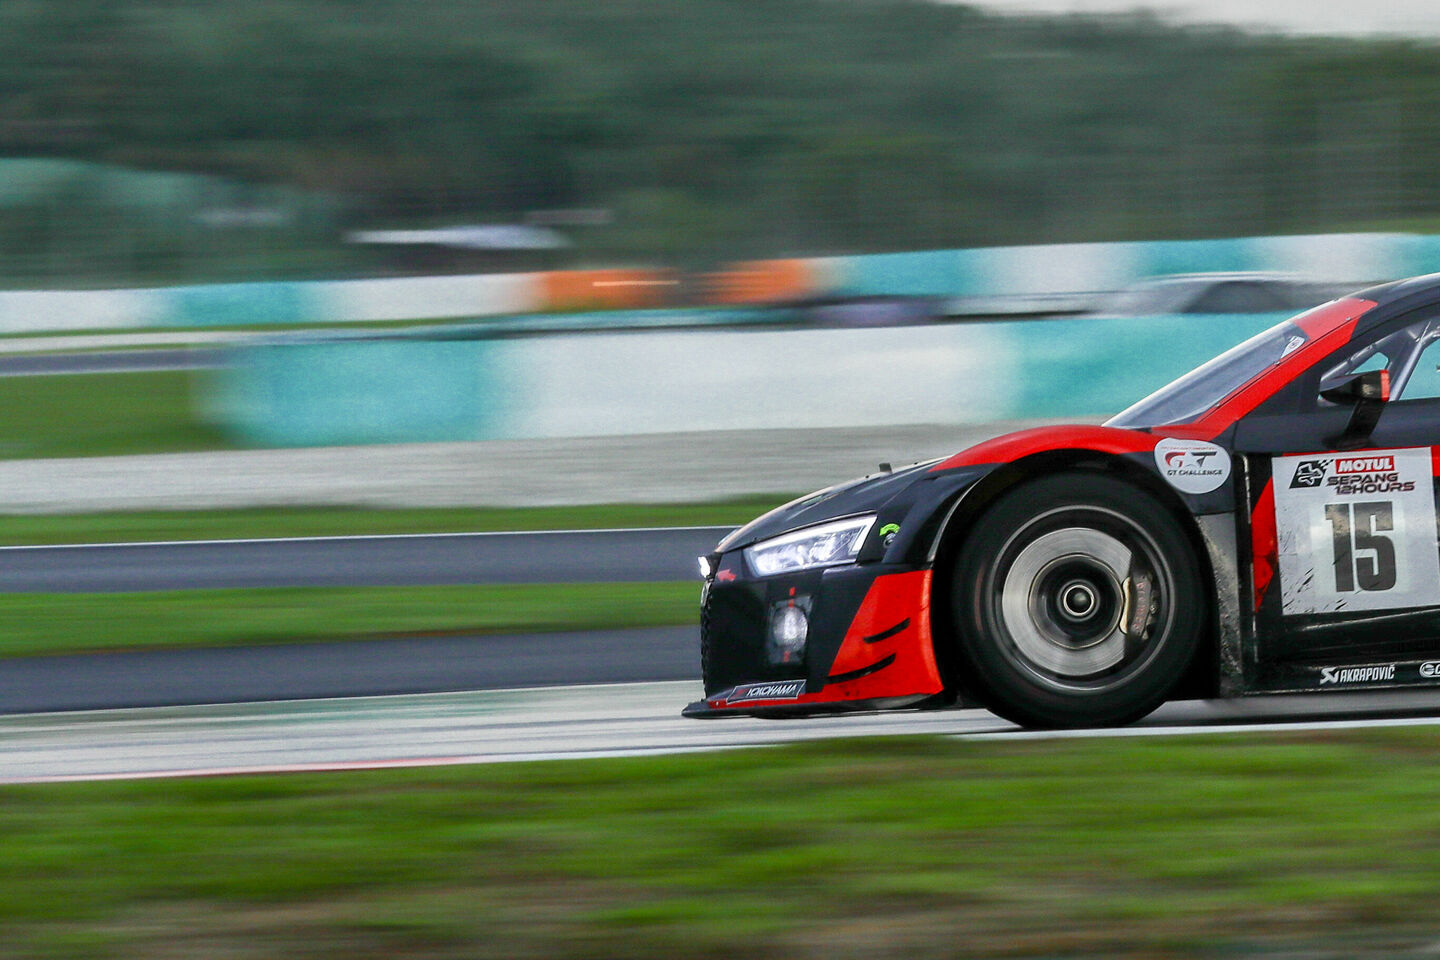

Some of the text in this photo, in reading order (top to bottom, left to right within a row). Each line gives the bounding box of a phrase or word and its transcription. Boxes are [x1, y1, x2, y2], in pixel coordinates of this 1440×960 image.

[1338, 459, 1393, 472] MOTUL
[1326, 472, 1399, 486] SEPANG
[1335, 481, 1416, 495] 12HOURS
[1324, 501, 1397, 593] 15
[1340, 664, 1396, 683] AKRAPOVIČ
[747, 684, 797, 697] YOKOHAMA
